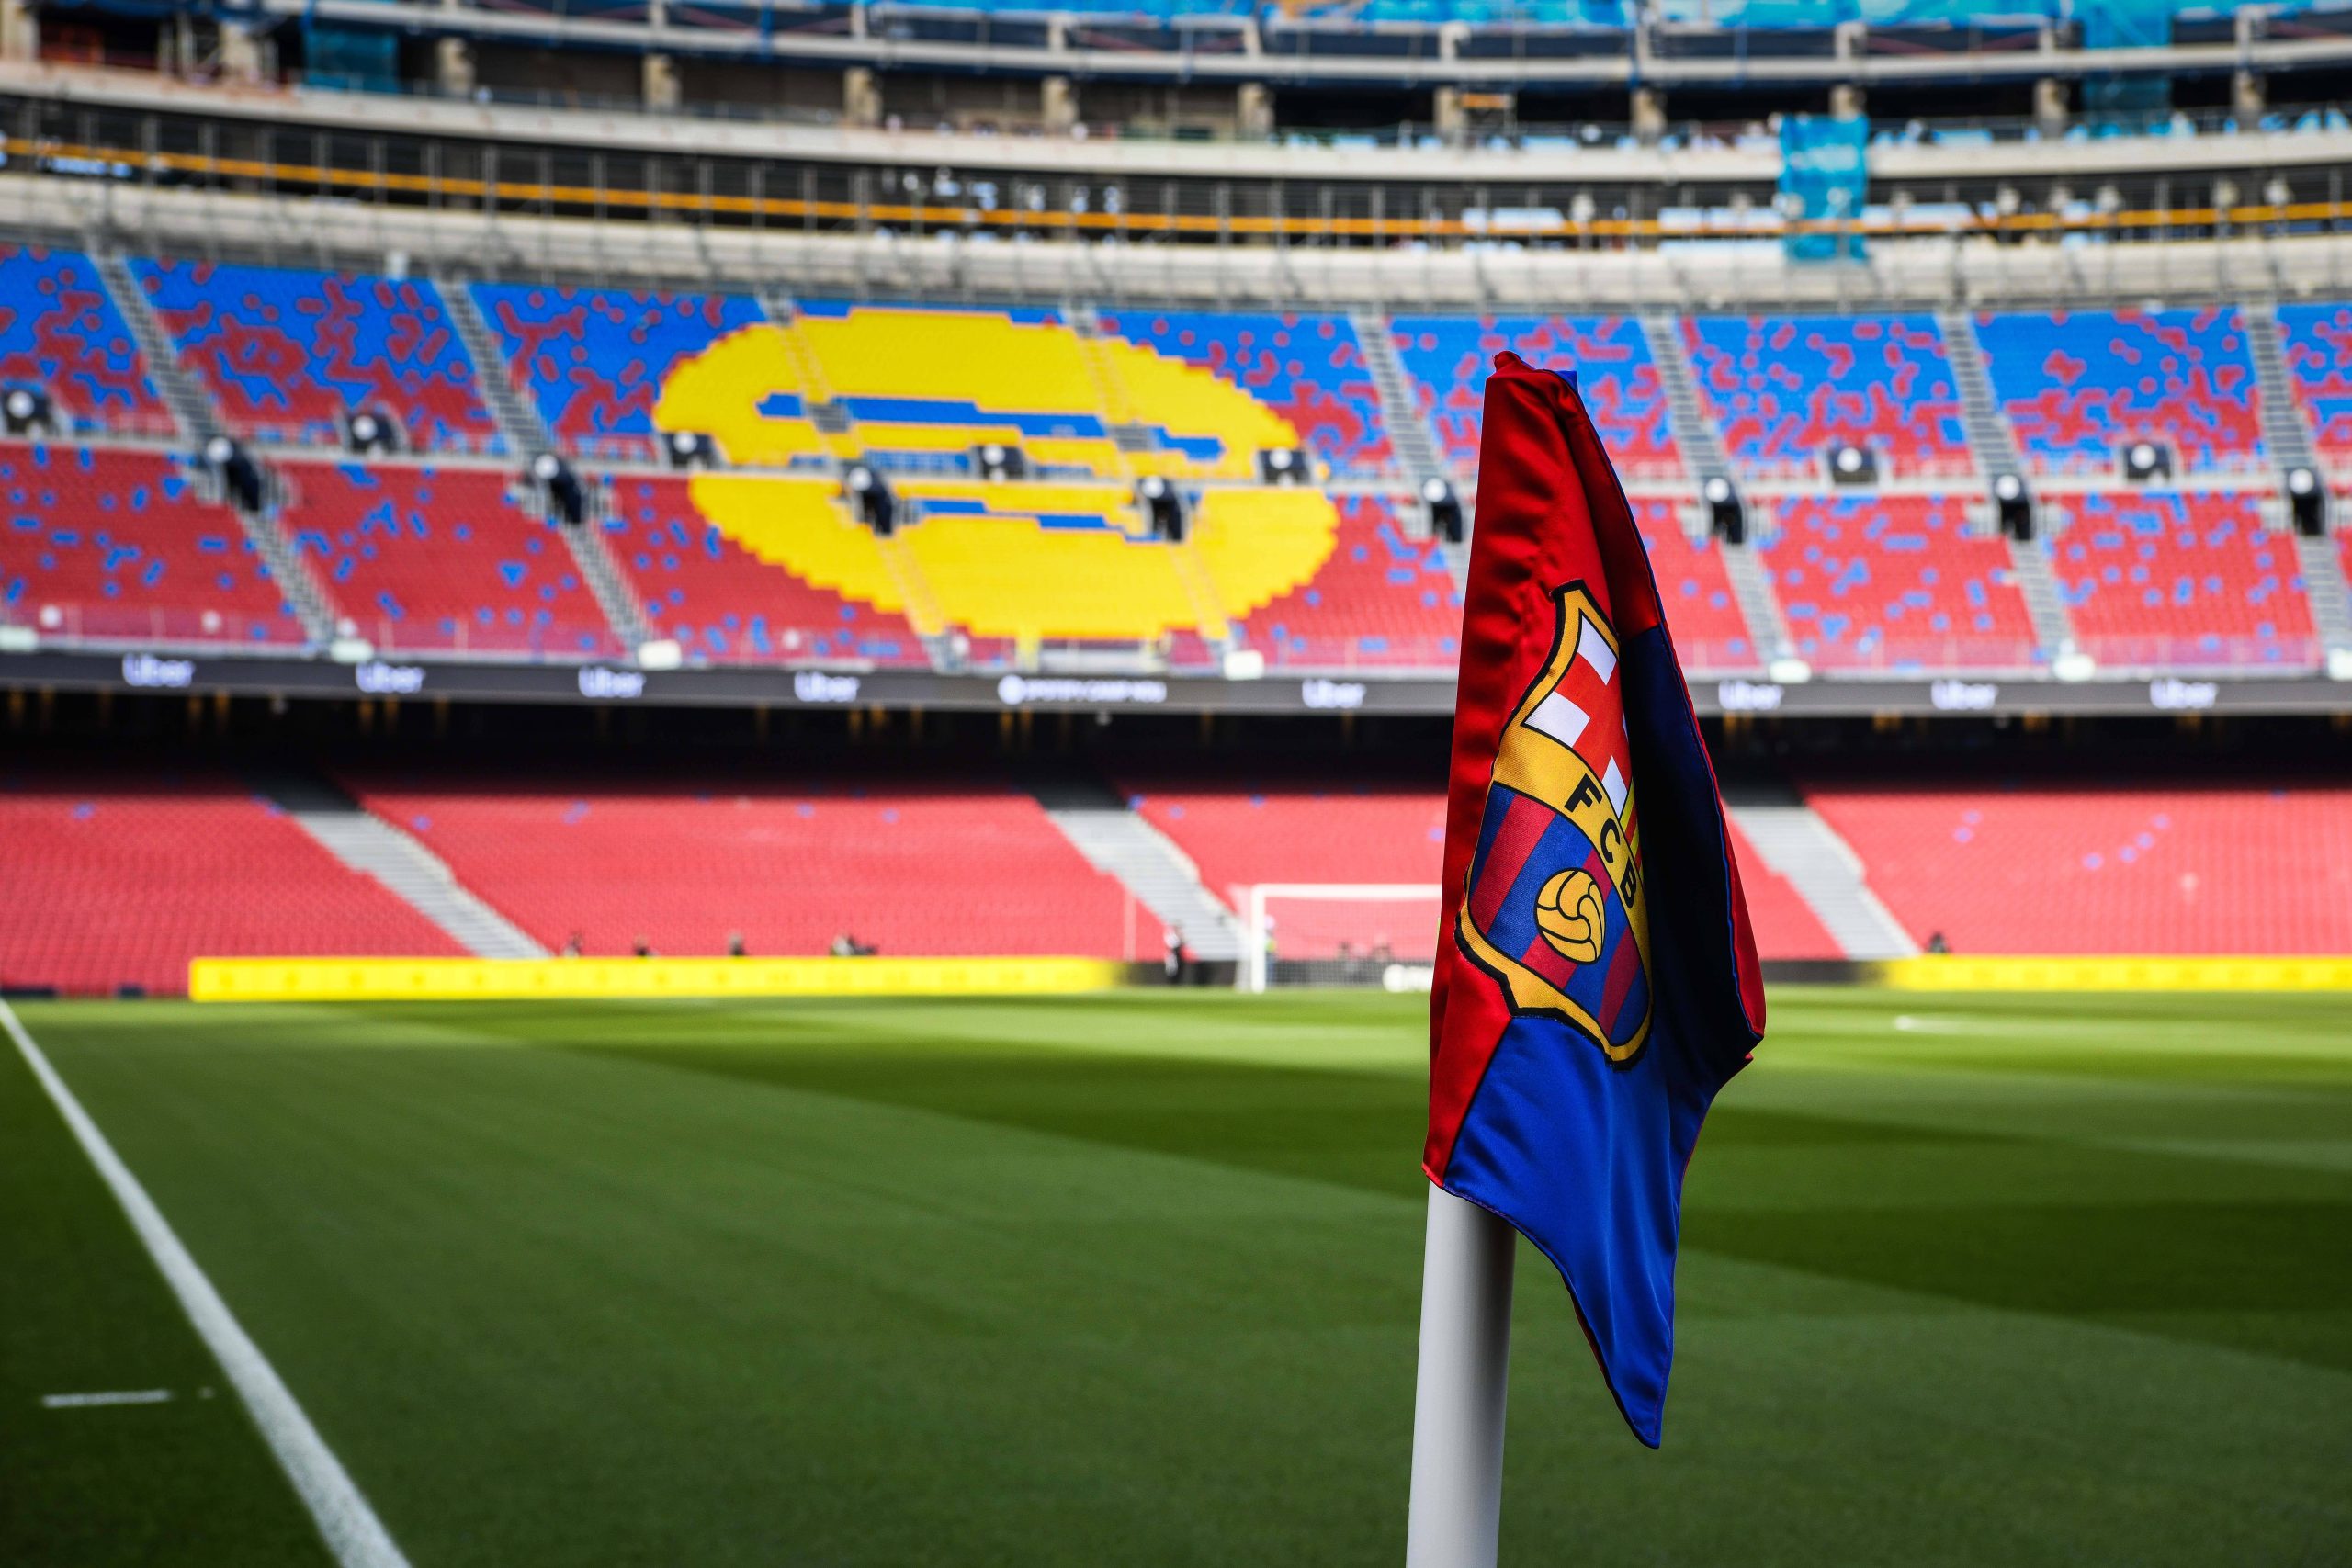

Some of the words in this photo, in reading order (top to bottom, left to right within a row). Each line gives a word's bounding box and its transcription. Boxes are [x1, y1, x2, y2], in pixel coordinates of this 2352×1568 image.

[122, 652, 195, 687] Uber
[356, 660, 424, 692] Uber
[1564, 773, 1637, 909] FCB
